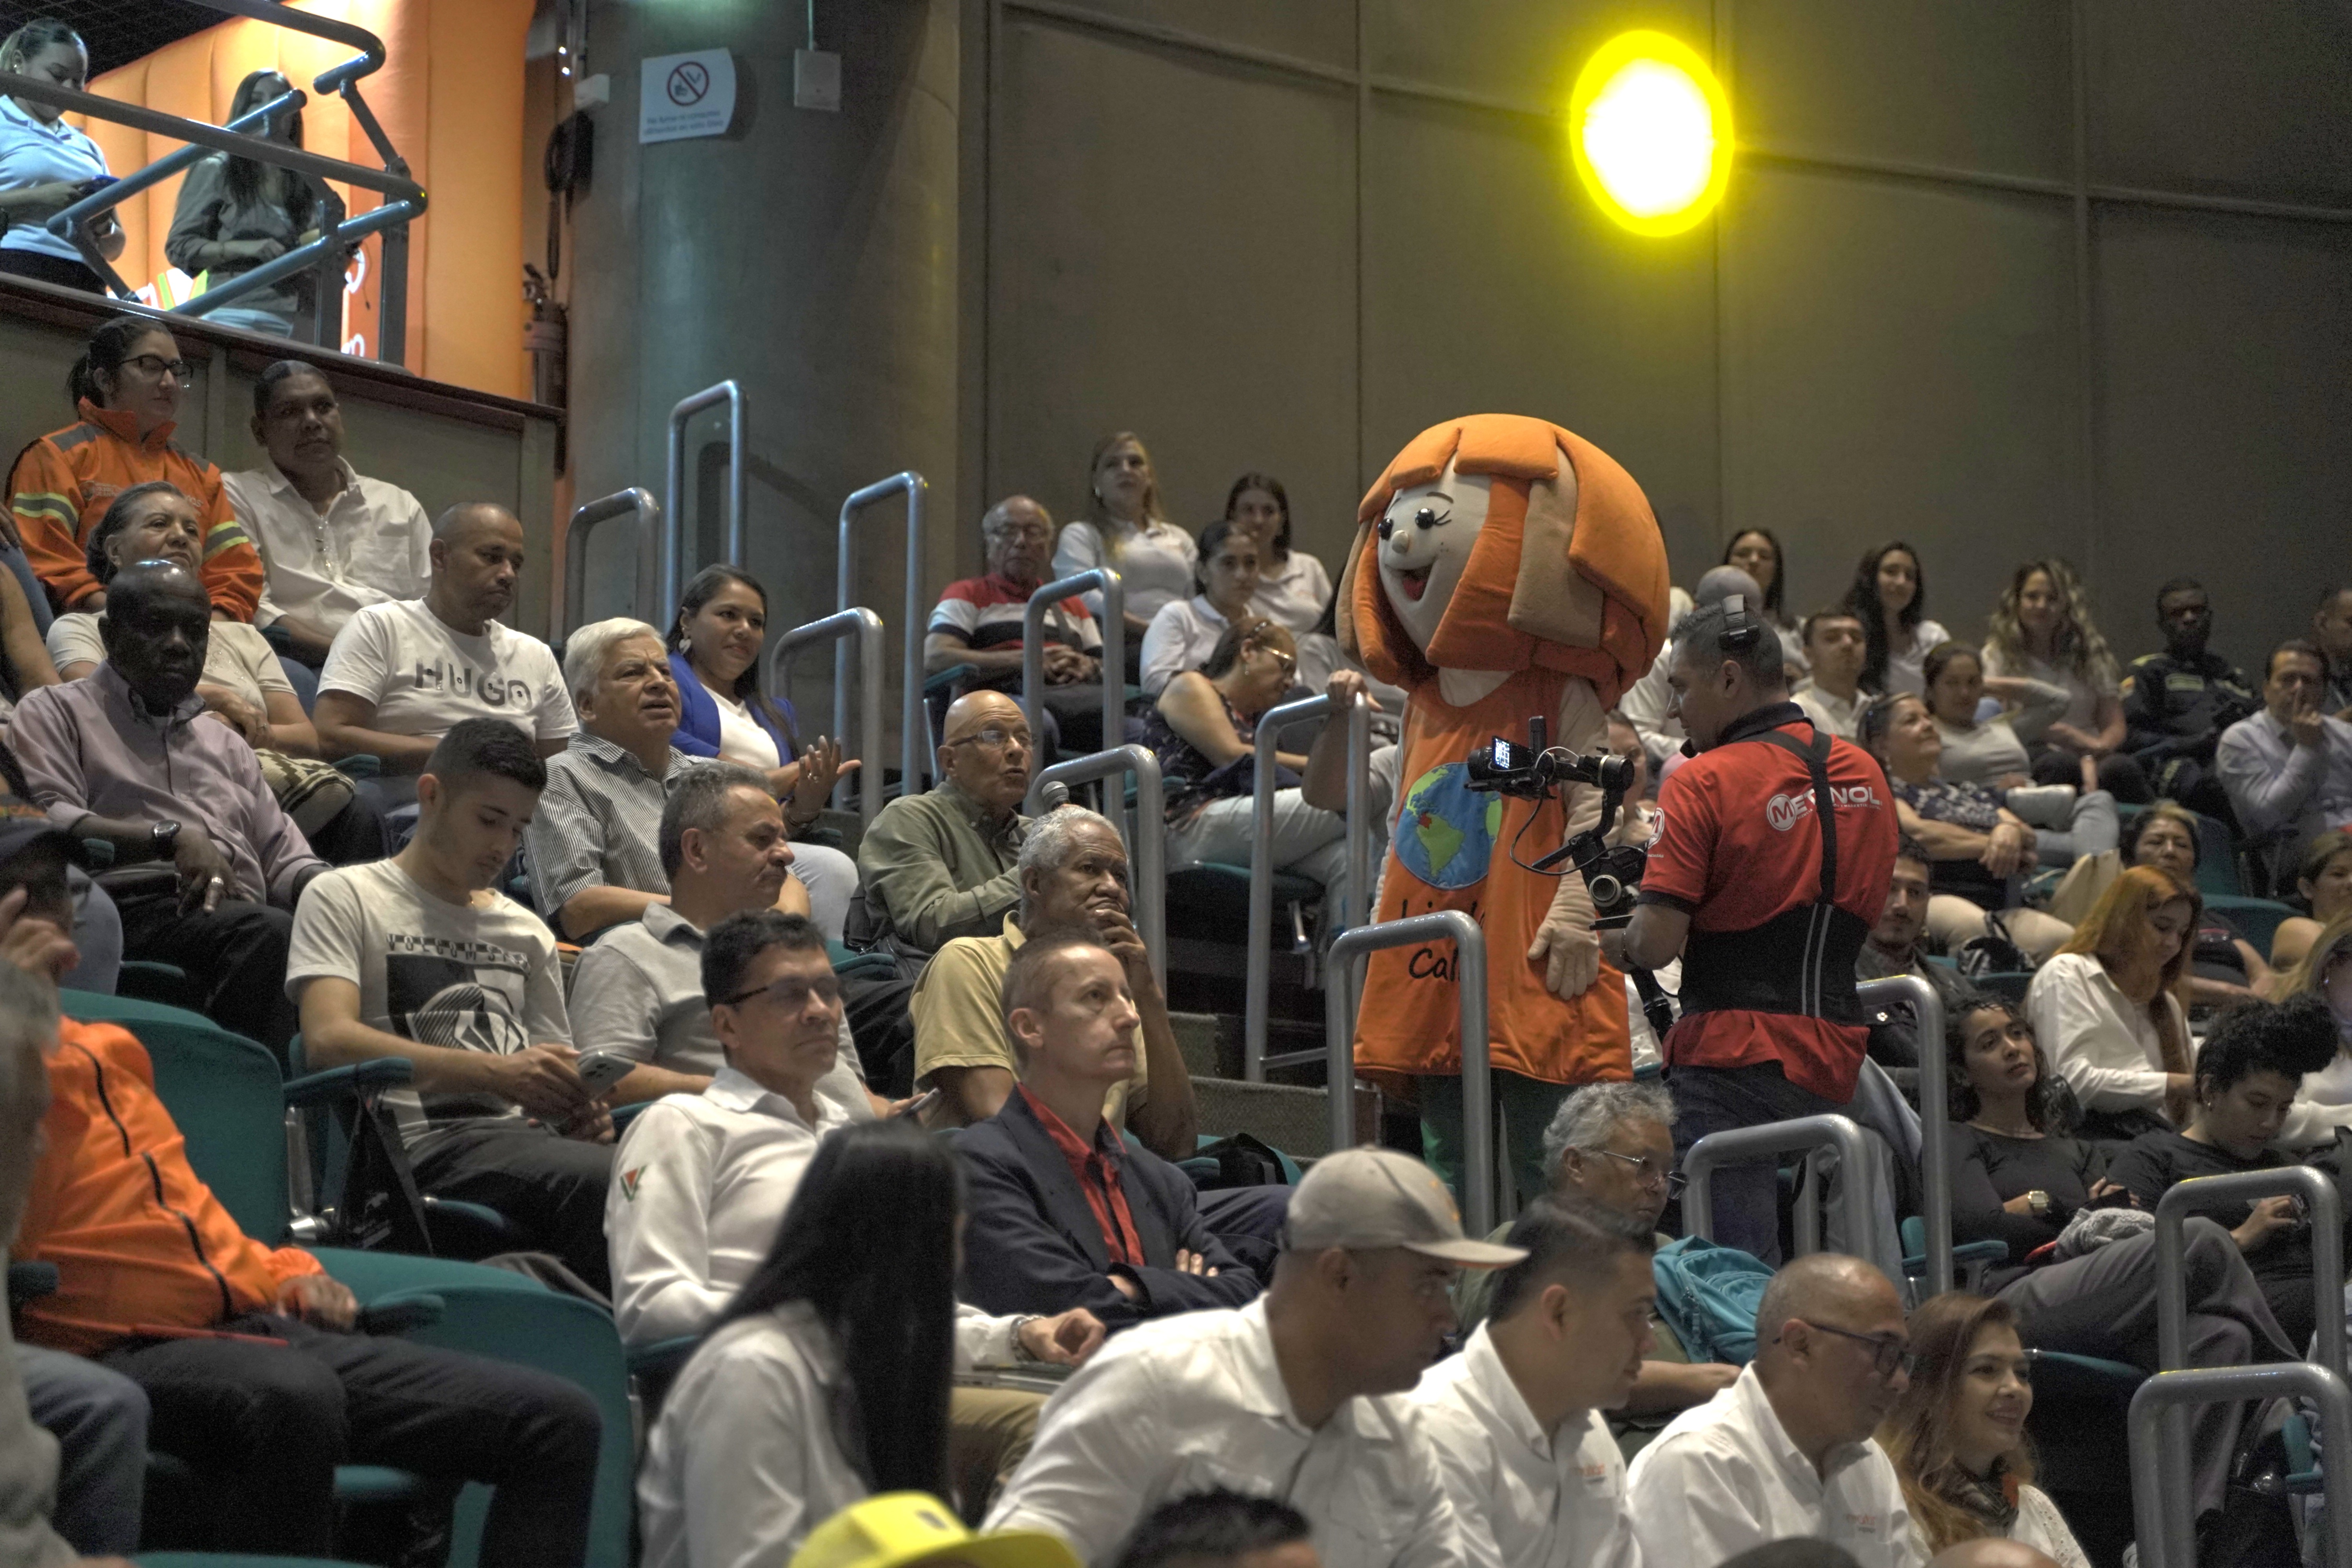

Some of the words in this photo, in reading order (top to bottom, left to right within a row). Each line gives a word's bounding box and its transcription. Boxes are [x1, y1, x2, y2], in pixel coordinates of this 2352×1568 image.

[415, 659, 532, 711] HUGO
[1767, 786, 1880, 831] METNOL
[387, 934, 476, 960] VOLCOM
[1409, 948, 1460, 982] Cal
